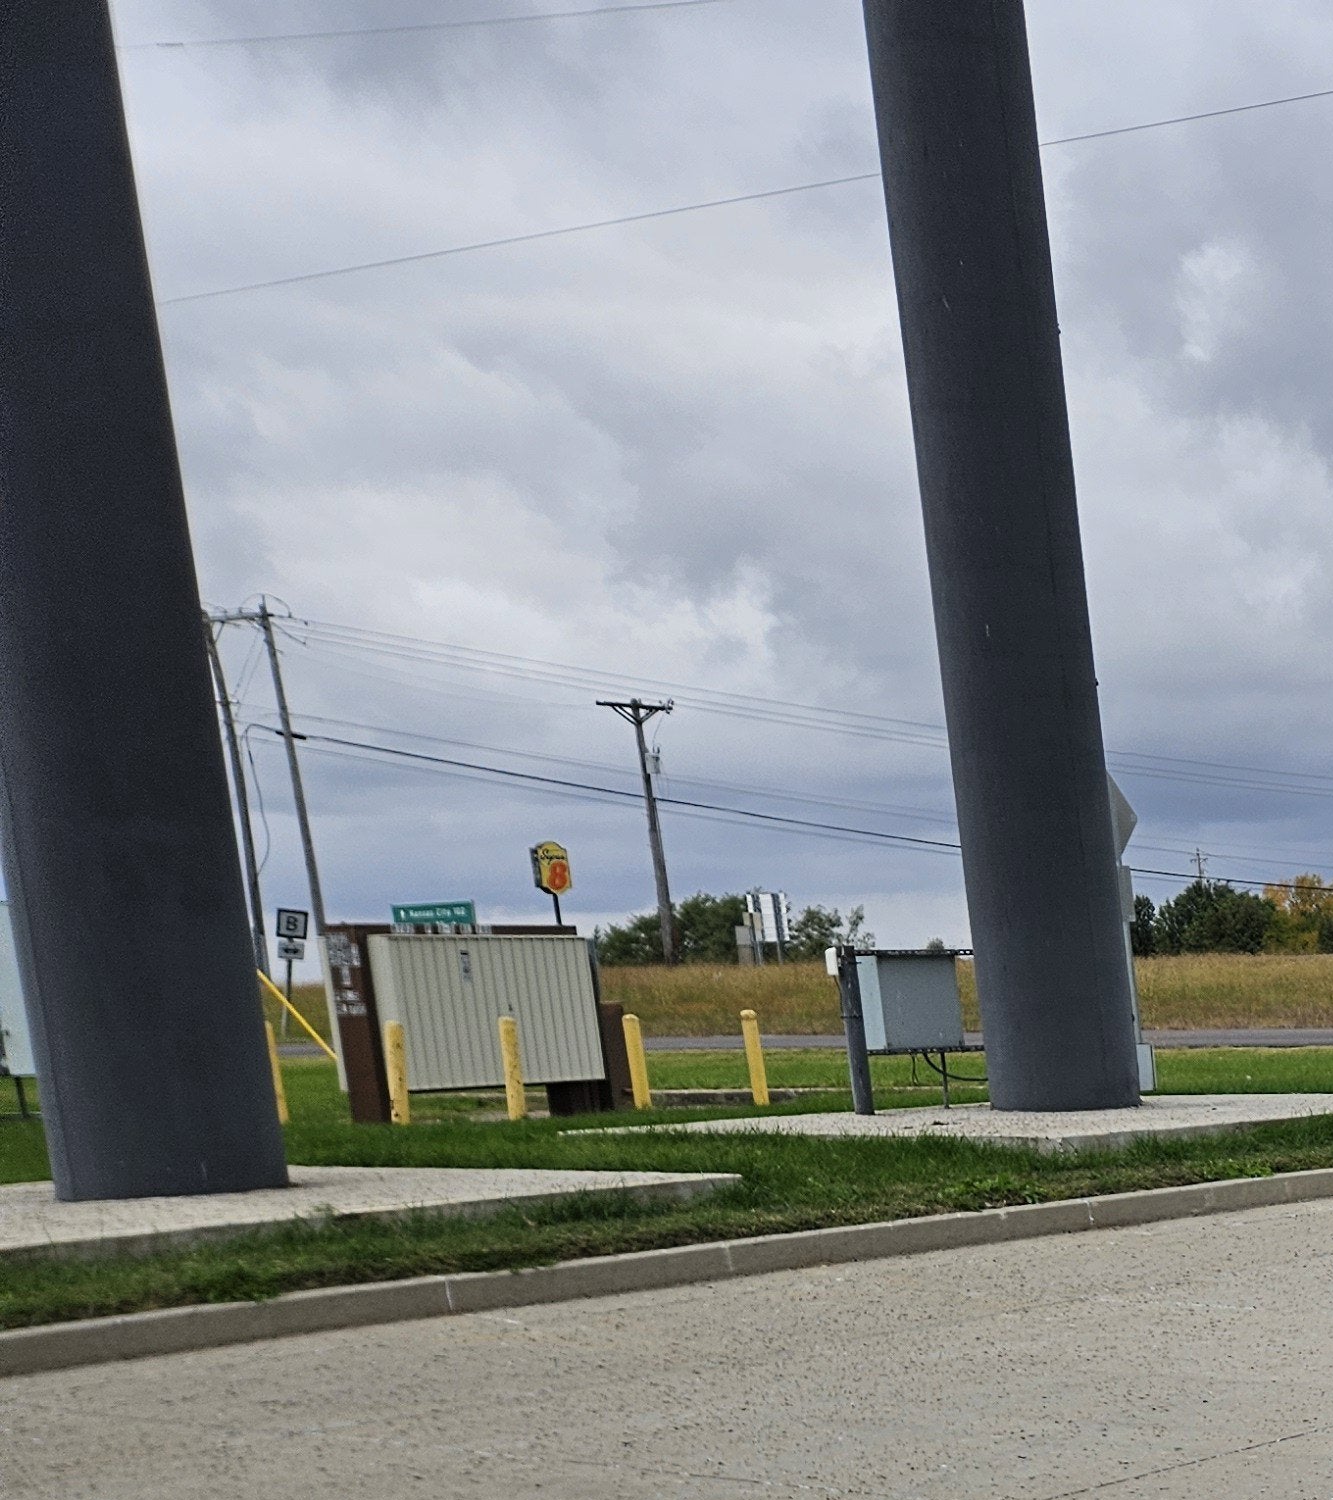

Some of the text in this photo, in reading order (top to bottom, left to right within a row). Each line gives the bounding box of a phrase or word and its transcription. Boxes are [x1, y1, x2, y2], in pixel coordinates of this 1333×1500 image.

[547, 860, 568, 891] 8
[408, 909, 434, 917] Kansas
[435, 907, 452, 917] City
[285, 915, 299, 931] B
